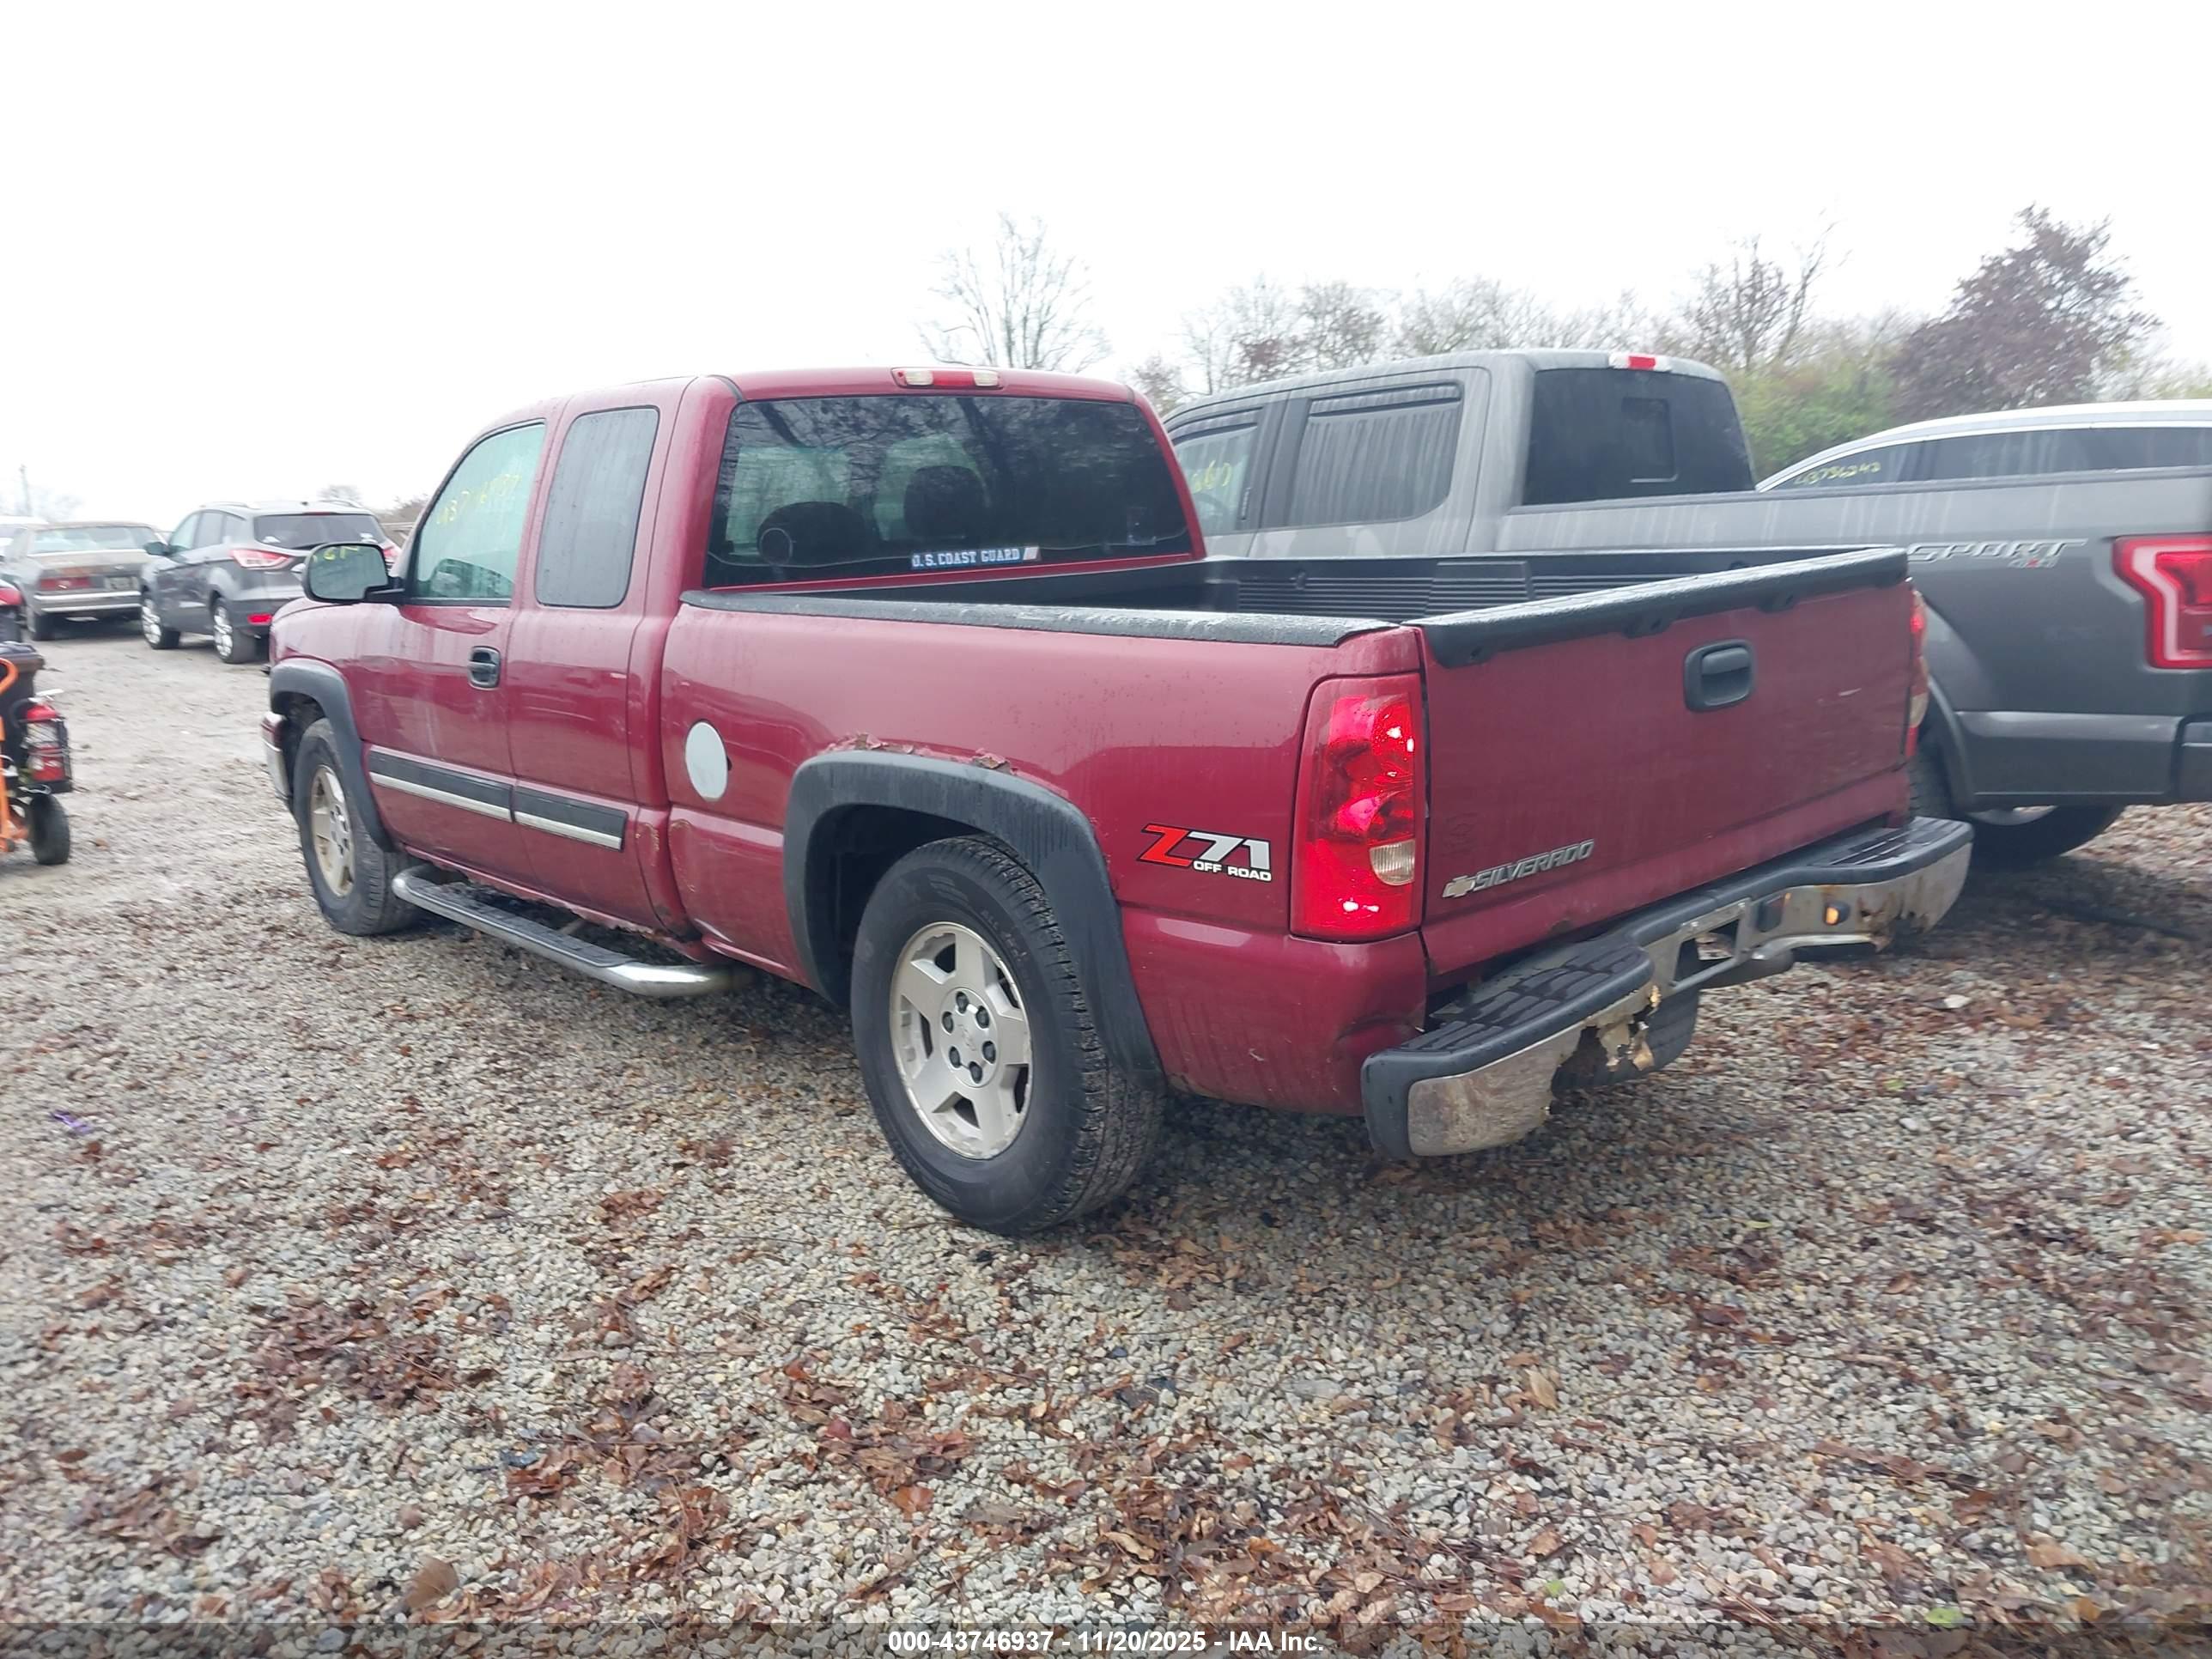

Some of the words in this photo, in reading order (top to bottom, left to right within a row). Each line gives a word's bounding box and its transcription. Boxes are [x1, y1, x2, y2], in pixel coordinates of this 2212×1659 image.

[938, 551, 976, 564] COAST
[981, 548, 1020, 561] GUARD
[1907, 538, 2088, 563] SPORT
[1137, 823, 1271, 871] Z71
[1193, 860, 1222, 873] OFF
[1228, 866, 1272, 882] ROAD
[1473, 838, 1595, 892] SILVERADO
